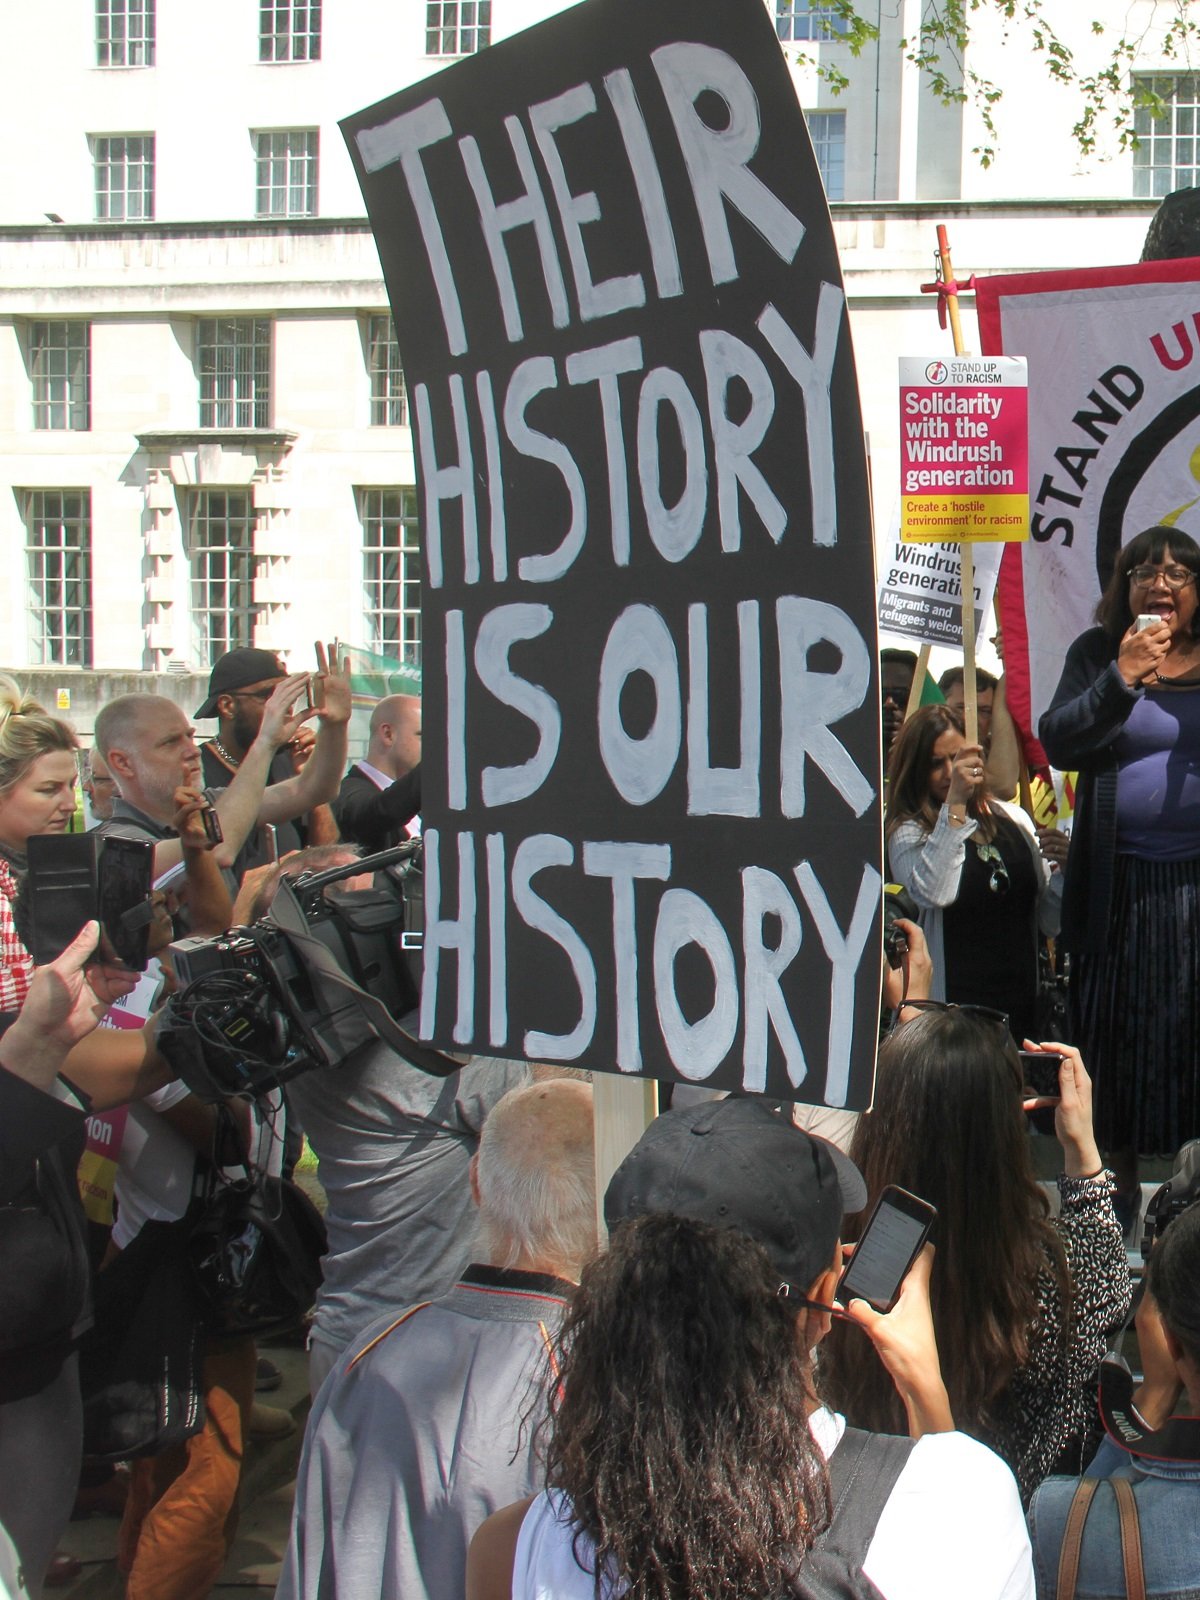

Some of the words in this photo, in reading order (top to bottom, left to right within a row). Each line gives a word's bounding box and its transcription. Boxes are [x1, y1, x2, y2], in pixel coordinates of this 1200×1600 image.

[355, 41, 806, 357] THEIR
[951, 362, 981, 373] STAND
[984, 363, 997, 373] UP
[951, 373, 964, 383] TO
[966, 373, 1002, 383] RACISM
[905, 392, 1003, 420] Solidarity
[415, 281, 844, 589] HISTORY
[905, 416, 949, 438] with
[955, 416, 989, 438] the
[905, 440, 1003, 462] Windrush
[1030, 364, 1145, 548] STAND
[905, 464, 1014, 492] generation
[907, 501, 939, 512] Create
[942, 504, 948, 512] a
[974, 514, 987, 525] for
[990, 513, 1022, 524] racism
[895, 543, 976, 579] Windrus
[887, 568, 982, 601] generatin
[880, 608, 926, 626] refugees
[882, 592, 930, 613] Migrants
[932, 605, 953, 618] and
[445, 602, 562, 811] IS
[597, 595, 877, 819] OUR
[419, 829, 882, 1107] HISTORY
